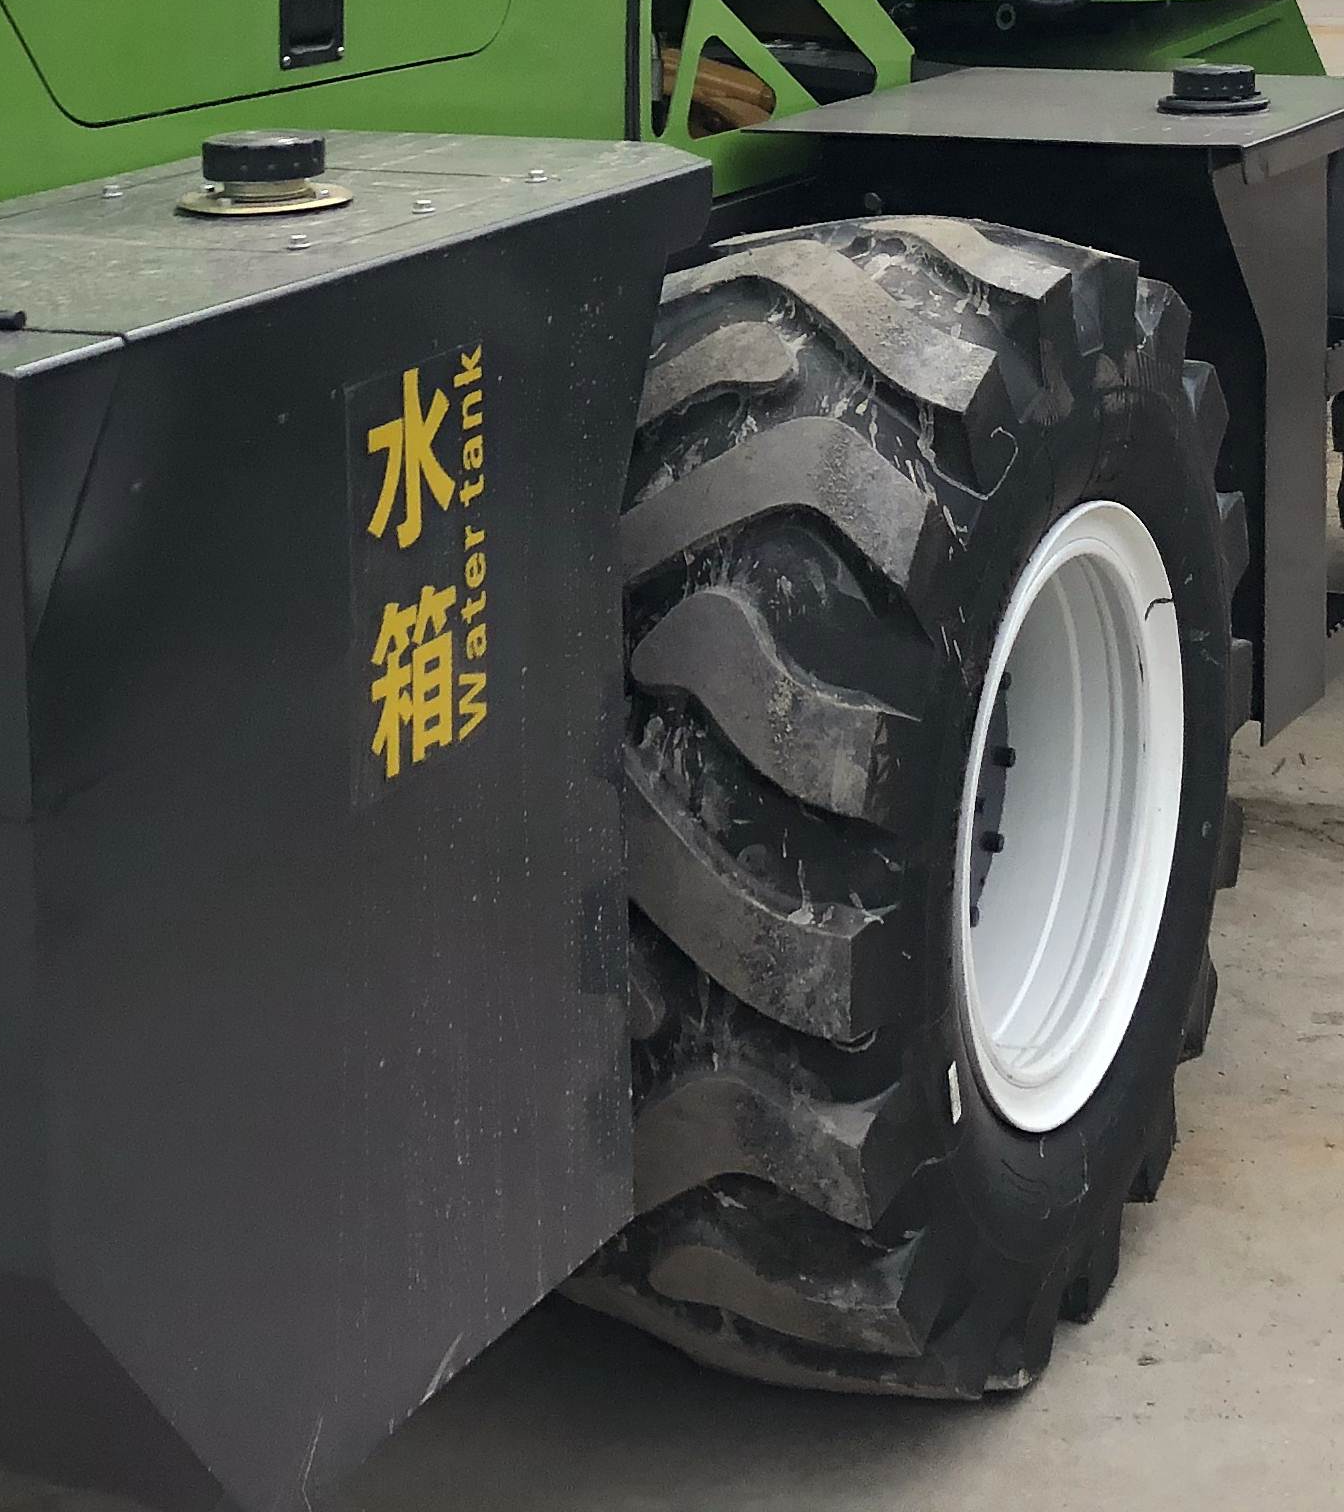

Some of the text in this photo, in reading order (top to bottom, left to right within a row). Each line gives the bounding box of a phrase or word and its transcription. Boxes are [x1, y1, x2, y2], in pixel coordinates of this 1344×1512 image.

[368, 368, 457, 779] 水箱
[453, 344, 488, 742] Water tank
